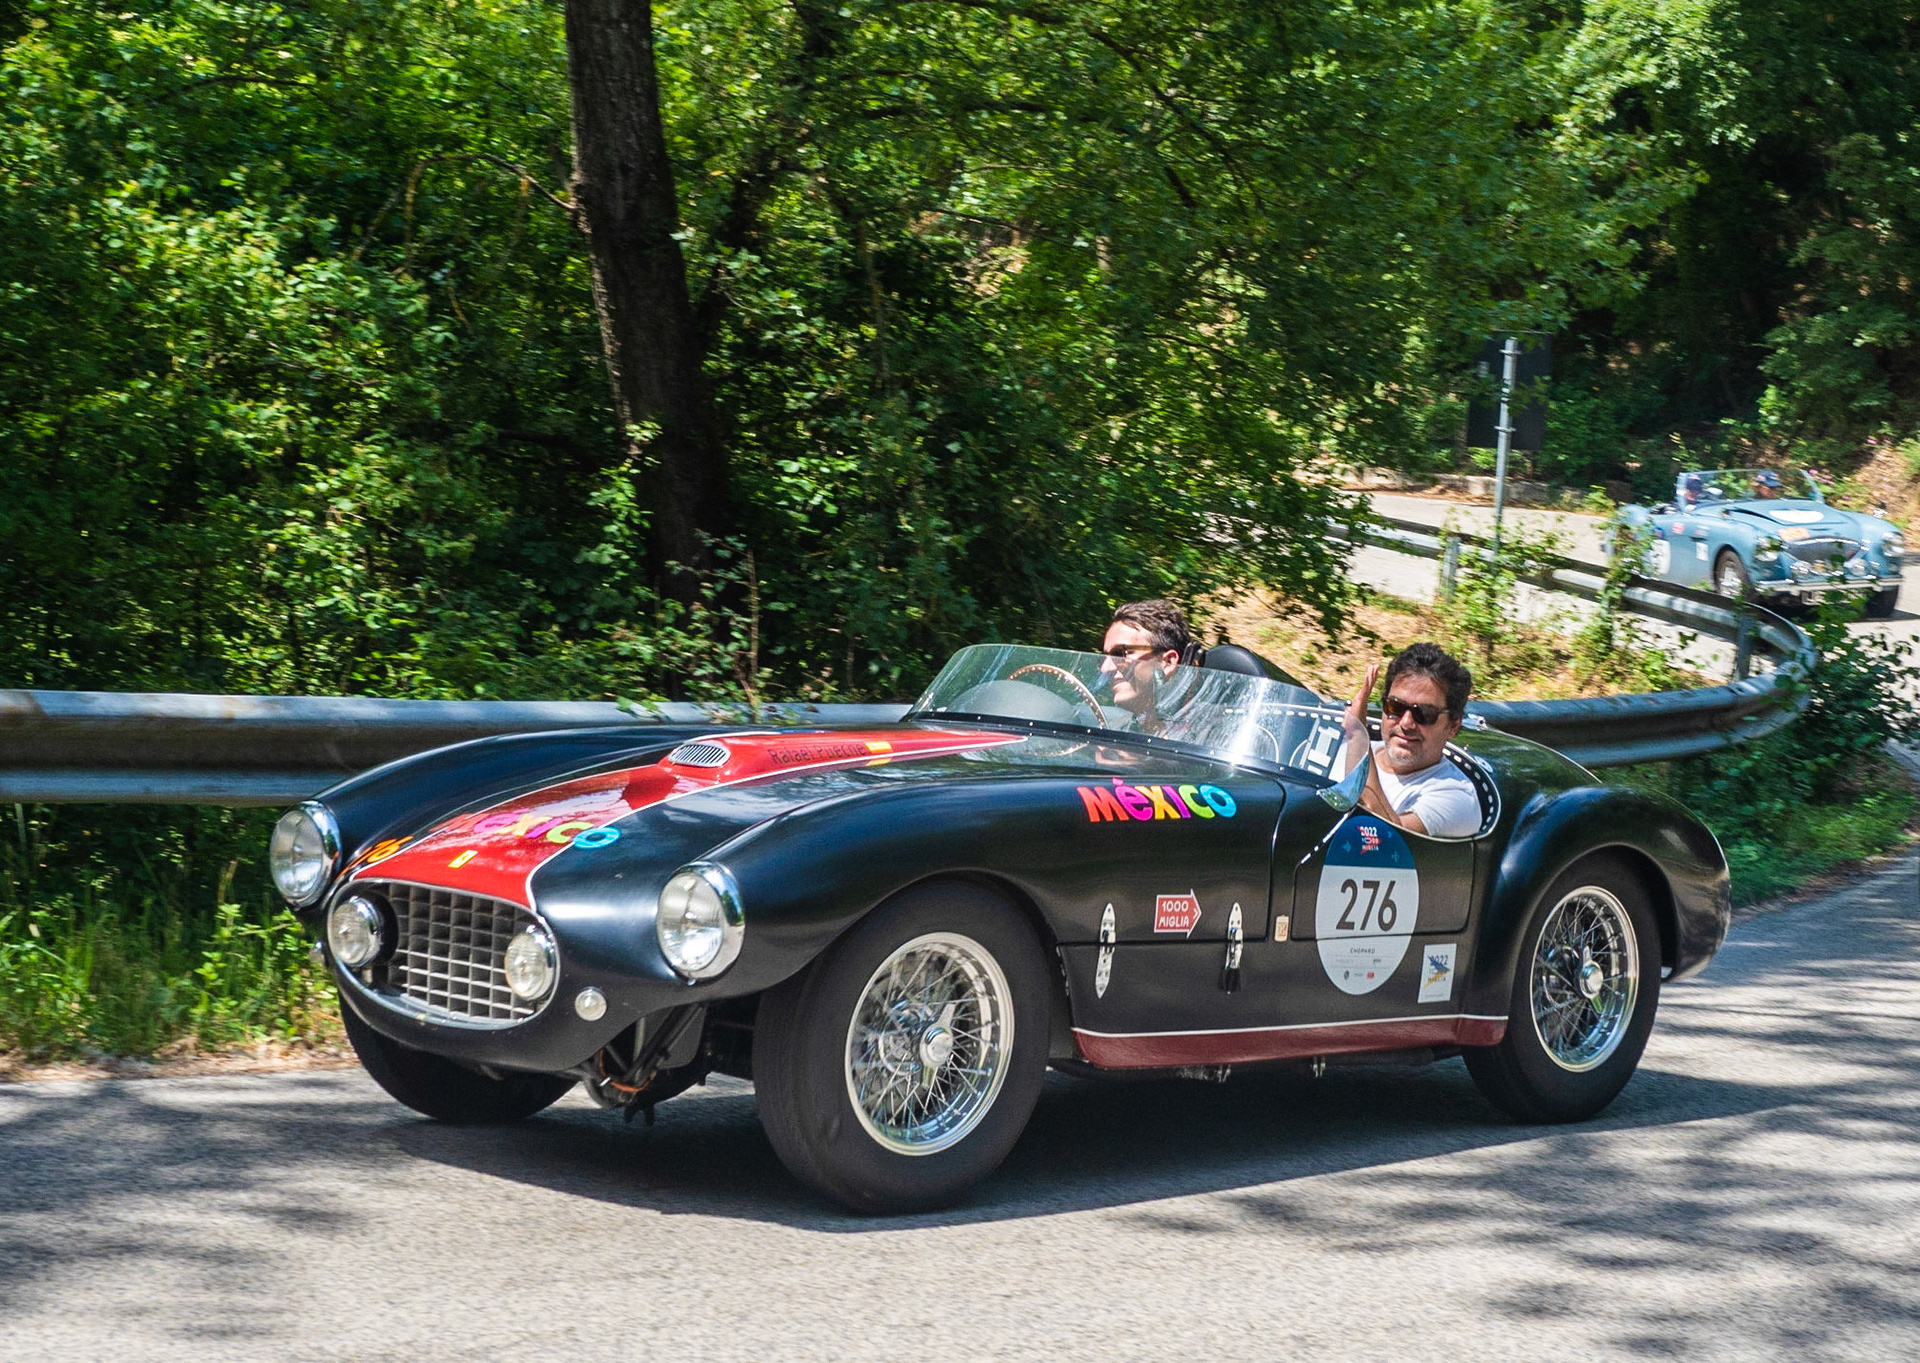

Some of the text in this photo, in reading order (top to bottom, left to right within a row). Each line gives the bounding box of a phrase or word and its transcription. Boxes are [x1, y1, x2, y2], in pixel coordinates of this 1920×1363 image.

[1360, 826, 1378, 837] 2022
[1161, 900, 1189, 912] 1000
[1335, 878, 1398, 932] 276
[1158, 915, 1191, 928] MIGLIA
